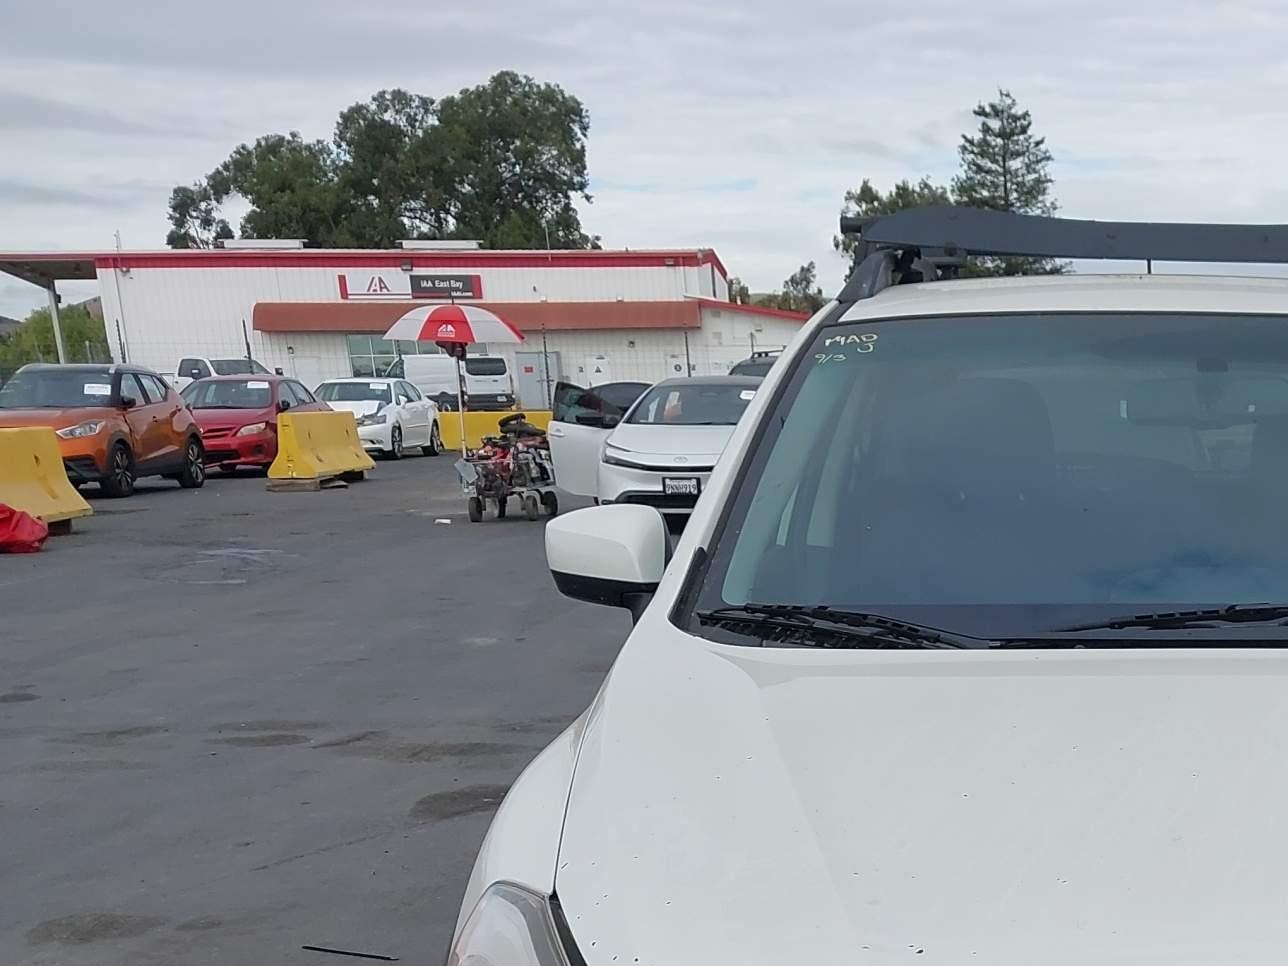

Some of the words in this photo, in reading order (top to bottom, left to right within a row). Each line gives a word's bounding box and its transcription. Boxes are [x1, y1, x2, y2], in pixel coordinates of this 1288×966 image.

[420, 279, 433, 288] IAA
[435, 279, 450, 288] East
[450, 279, 463, 289] Bay
[814, 353, 847, 364] 9/3
